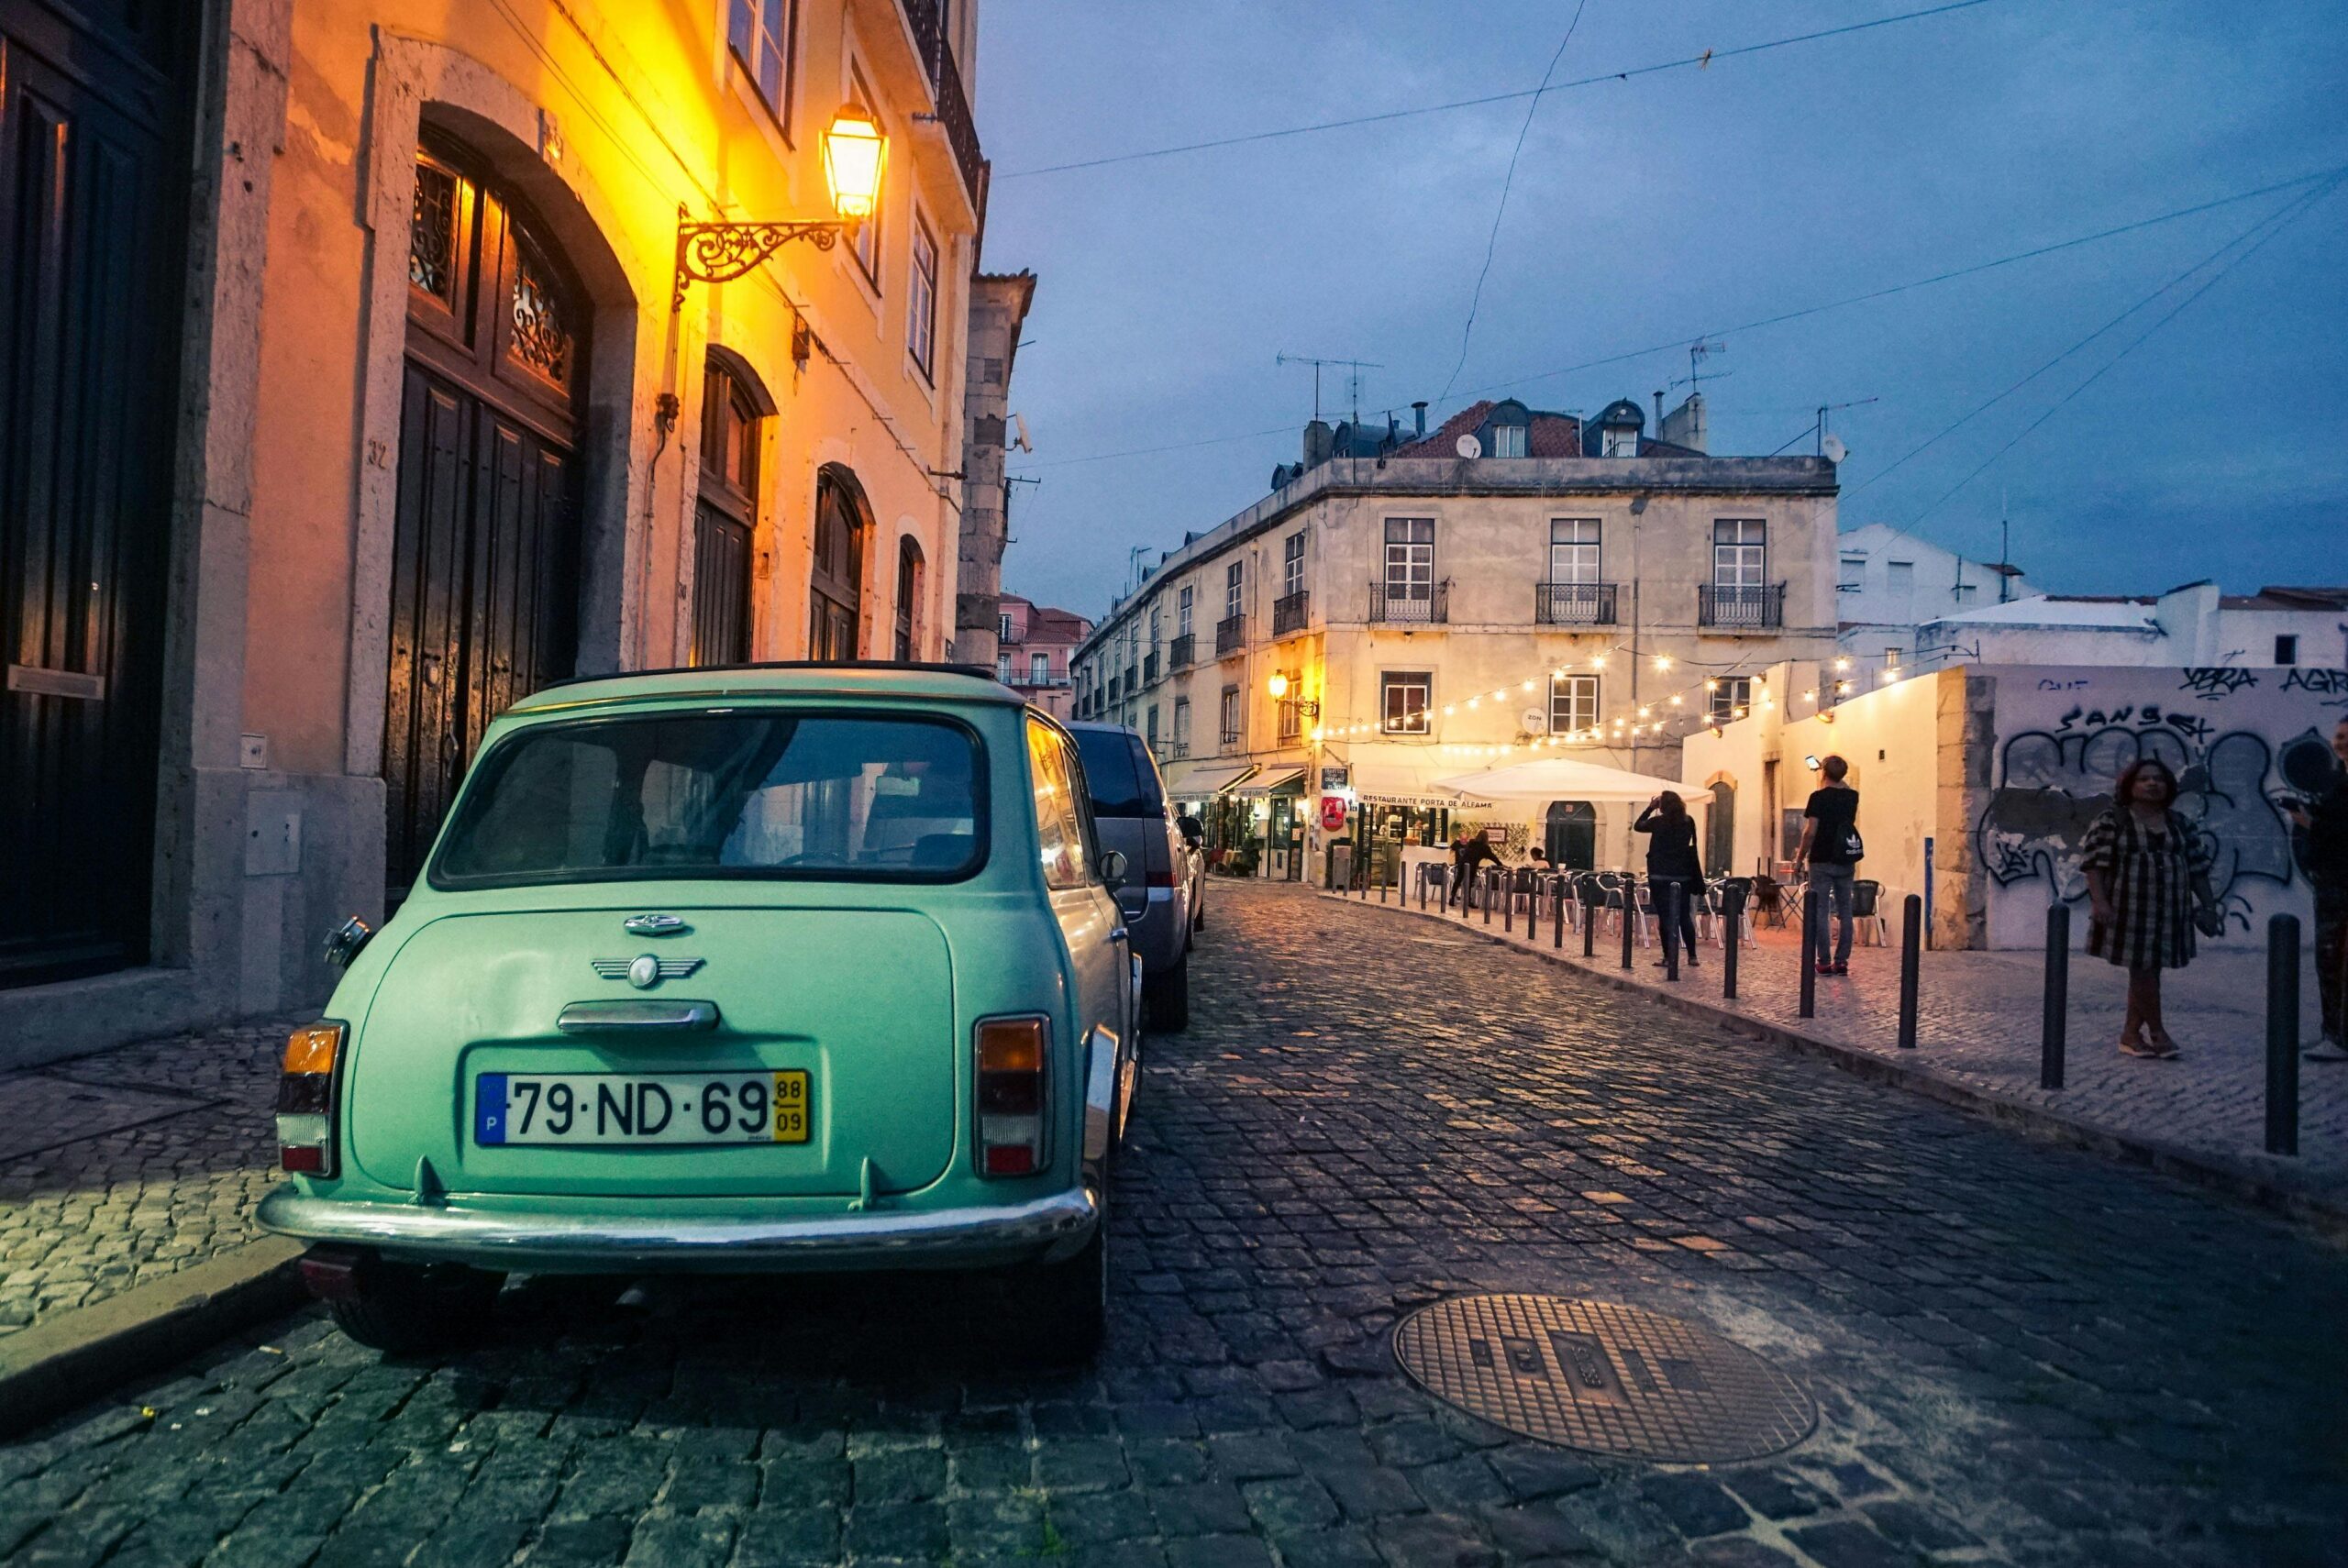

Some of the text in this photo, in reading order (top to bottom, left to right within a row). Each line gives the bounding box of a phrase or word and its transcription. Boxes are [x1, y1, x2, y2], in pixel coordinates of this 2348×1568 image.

[1363, 794, 1417, 805] RESTAURANTE
[1421, 799, 1445, 807] PORTA
[1461, 801, 1492, 809] ALFAMA
[777, 1080, 801, 1099] 88
[486, 1116, 497, 1131] P
[777, 1113, 801, 1132] 09
